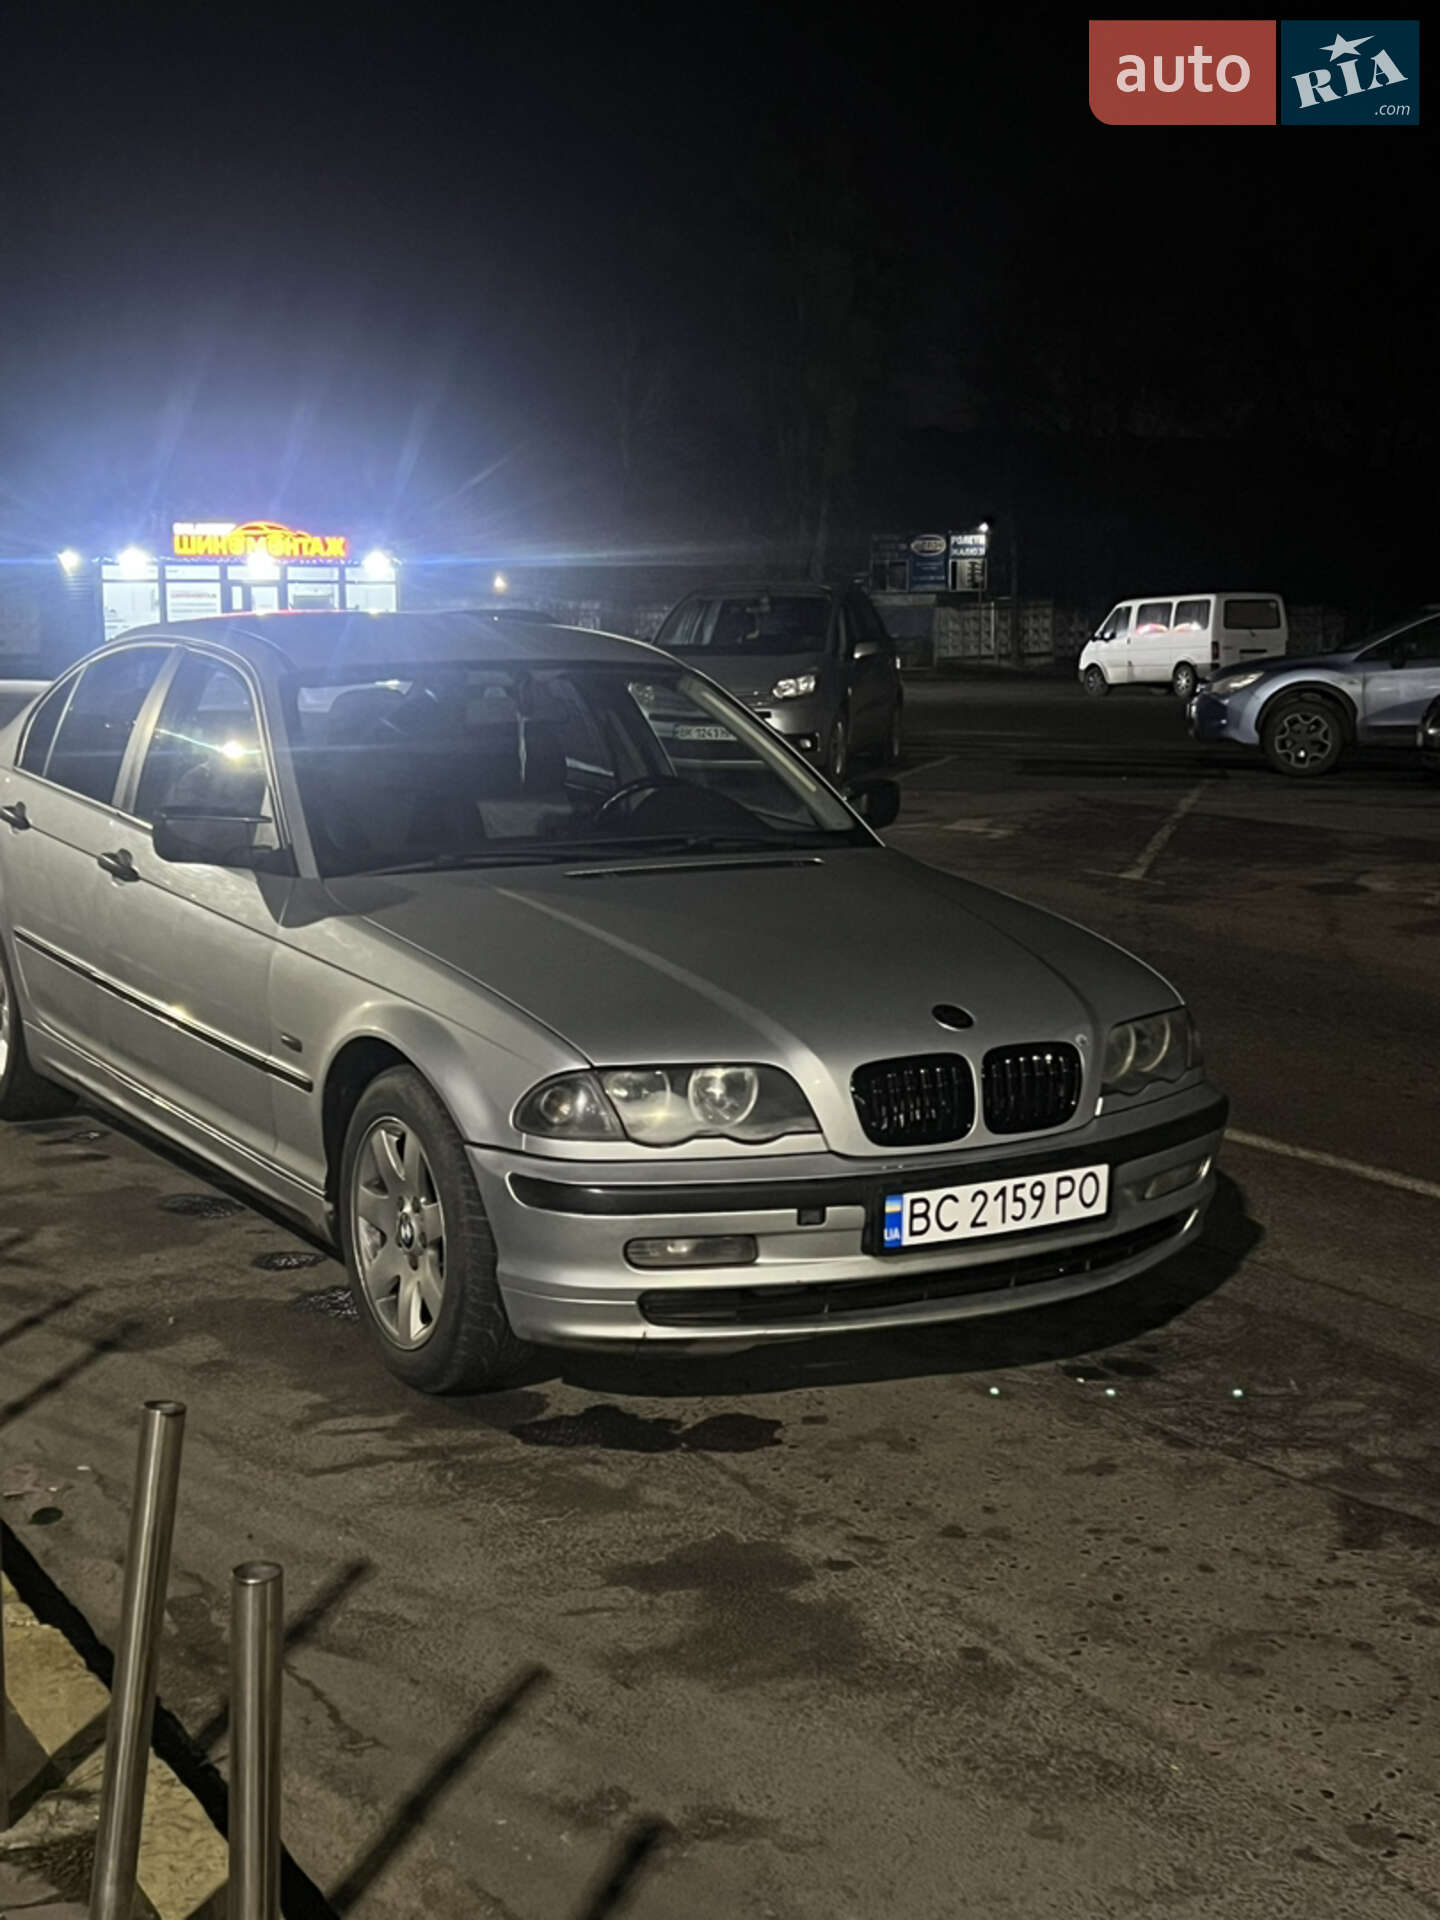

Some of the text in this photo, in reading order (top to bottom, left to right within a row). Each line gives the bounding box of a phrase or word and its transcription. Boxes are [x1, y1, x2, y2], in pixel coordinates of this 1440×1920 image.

[173, 534, 347, 558] ШИНОМОНТАЖ
[909, 1171, 1100, 1237] BC 2159 PO
[884, 1228, 900, 1241] UA
